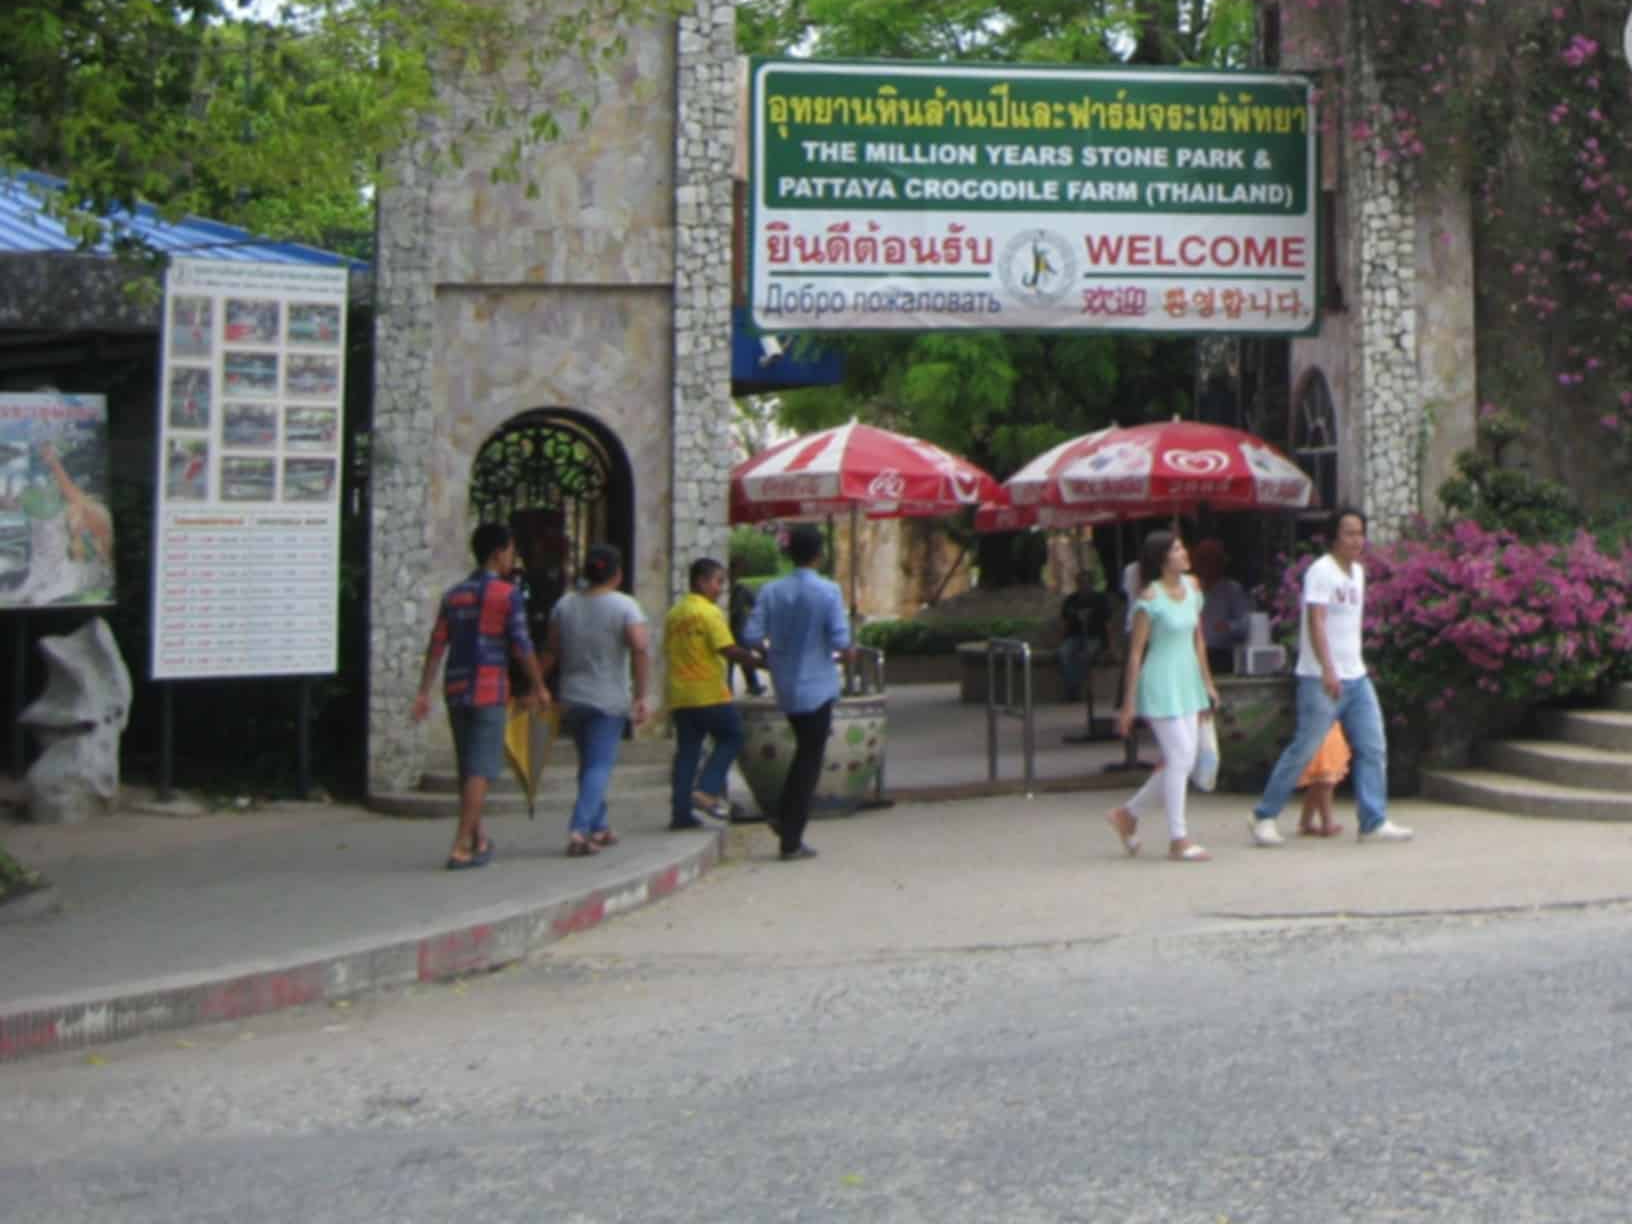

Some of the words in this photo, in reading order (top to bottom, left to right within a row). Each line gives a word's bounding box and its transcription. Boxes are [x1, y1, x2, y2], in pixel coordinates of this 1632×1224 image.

[802, 140, 857, 163] THE
[864, 141, 977, 164] MILLION
[985, 144, 1073, 167] YEARS
[1081, 145, 1168, 168] STONE
[1176, 148, 1246, 170] PARK
[1253, 149, 1273, 170] &
[778, 176, 897, 199] PATTAYA
[904, 178, 1059, 201] CROCODILE
[1067, 180, 1139, 203] FARM
[1146, 181, 1293, 208] (THAILAND)
[766, 220, 993, 265] ยินดีต้อนรับ
[1084, 234, 1306, 268] WELCOME
[763, 283, 846, 318] Добро
[852, 287, 1002, 314] пожаловать
